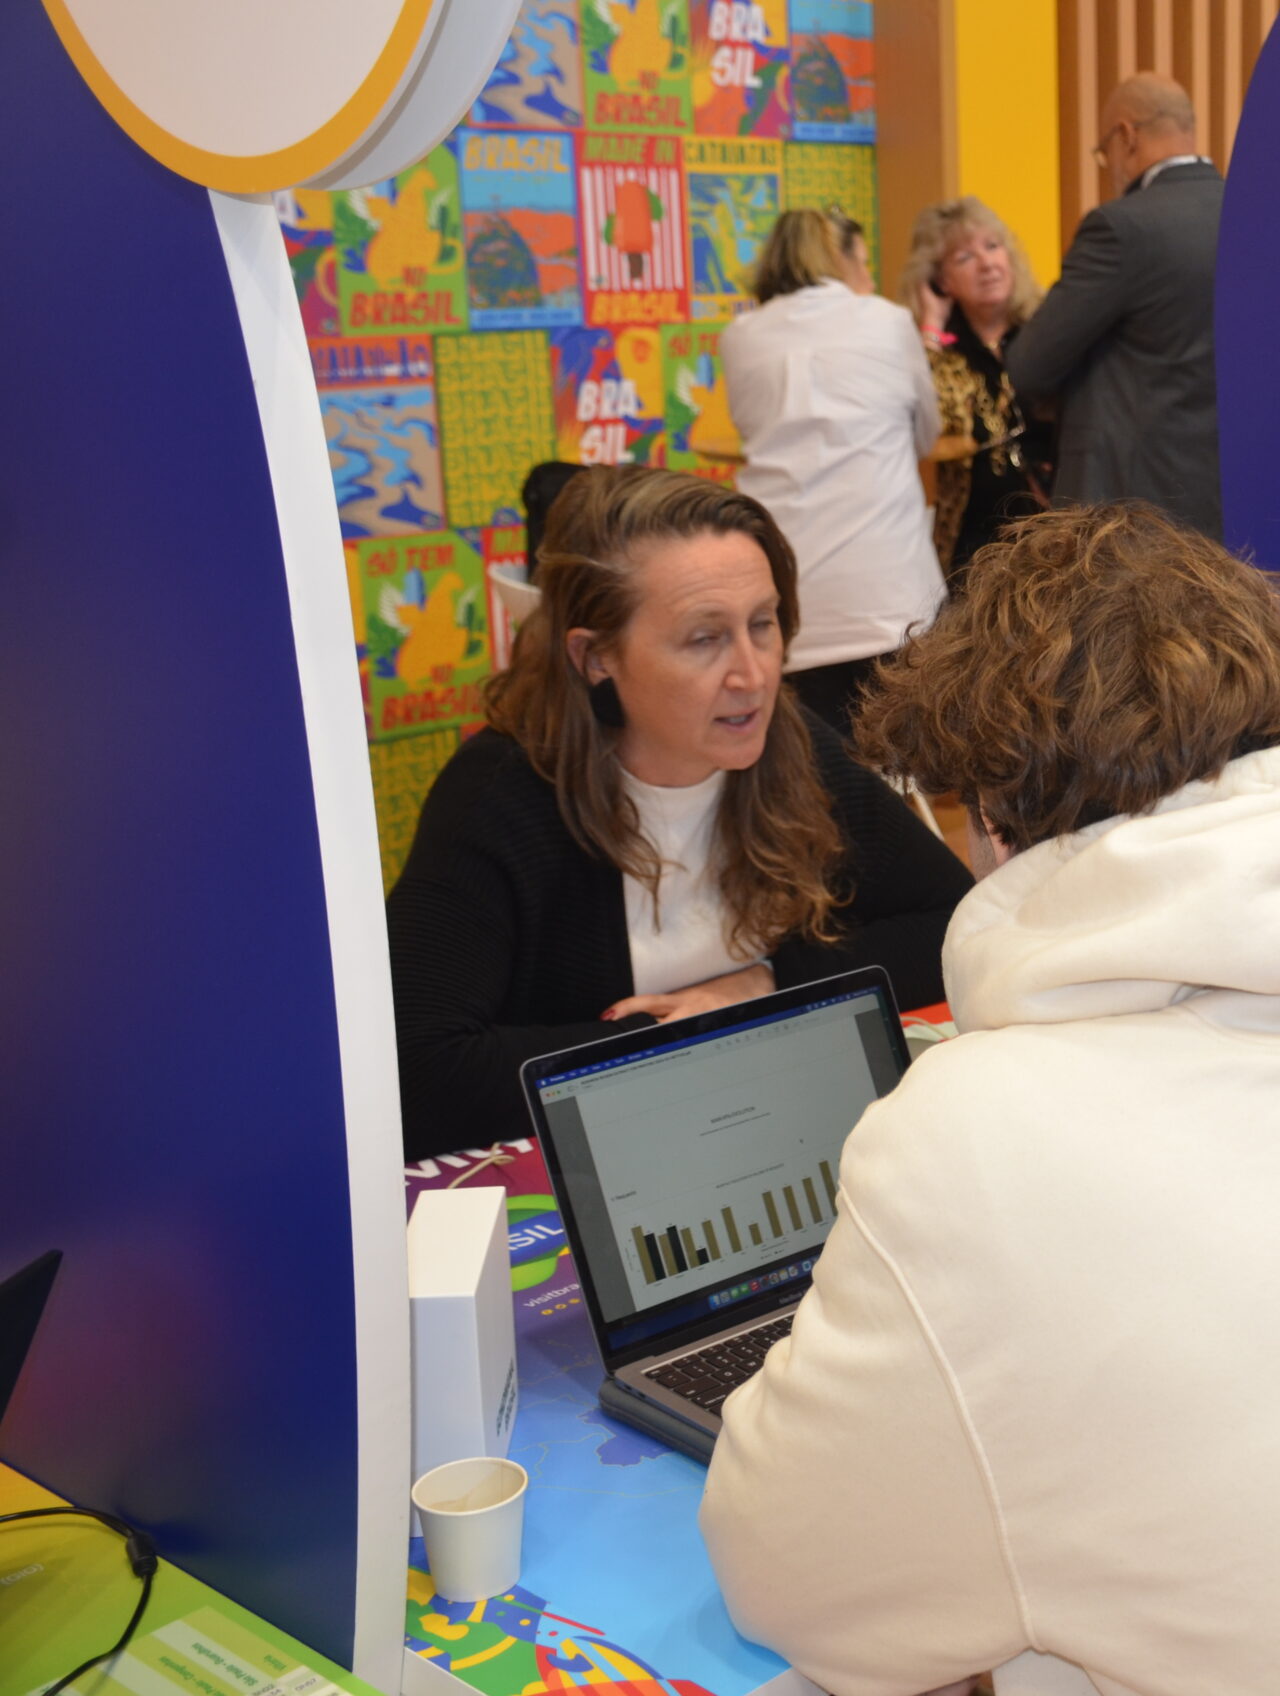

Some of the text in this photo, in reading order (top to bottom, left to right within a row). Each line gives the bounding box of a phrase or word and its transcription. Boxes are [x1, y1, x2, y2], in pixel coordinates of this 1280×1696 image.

[709, 1, 766, 43] BRA
[711, 45, 763, 89] SIL
[595, 92, 686, 128] BRASIL
[464, 135, 570, 173] BRASIL
[583, 135, 644, 164] MADE
[351, 290, 462, 328] BRASIL
[577, 378, 639, 422] BRA
[579, 424, 636, 466] SIL
[406, 544, 455, 572] TEM
